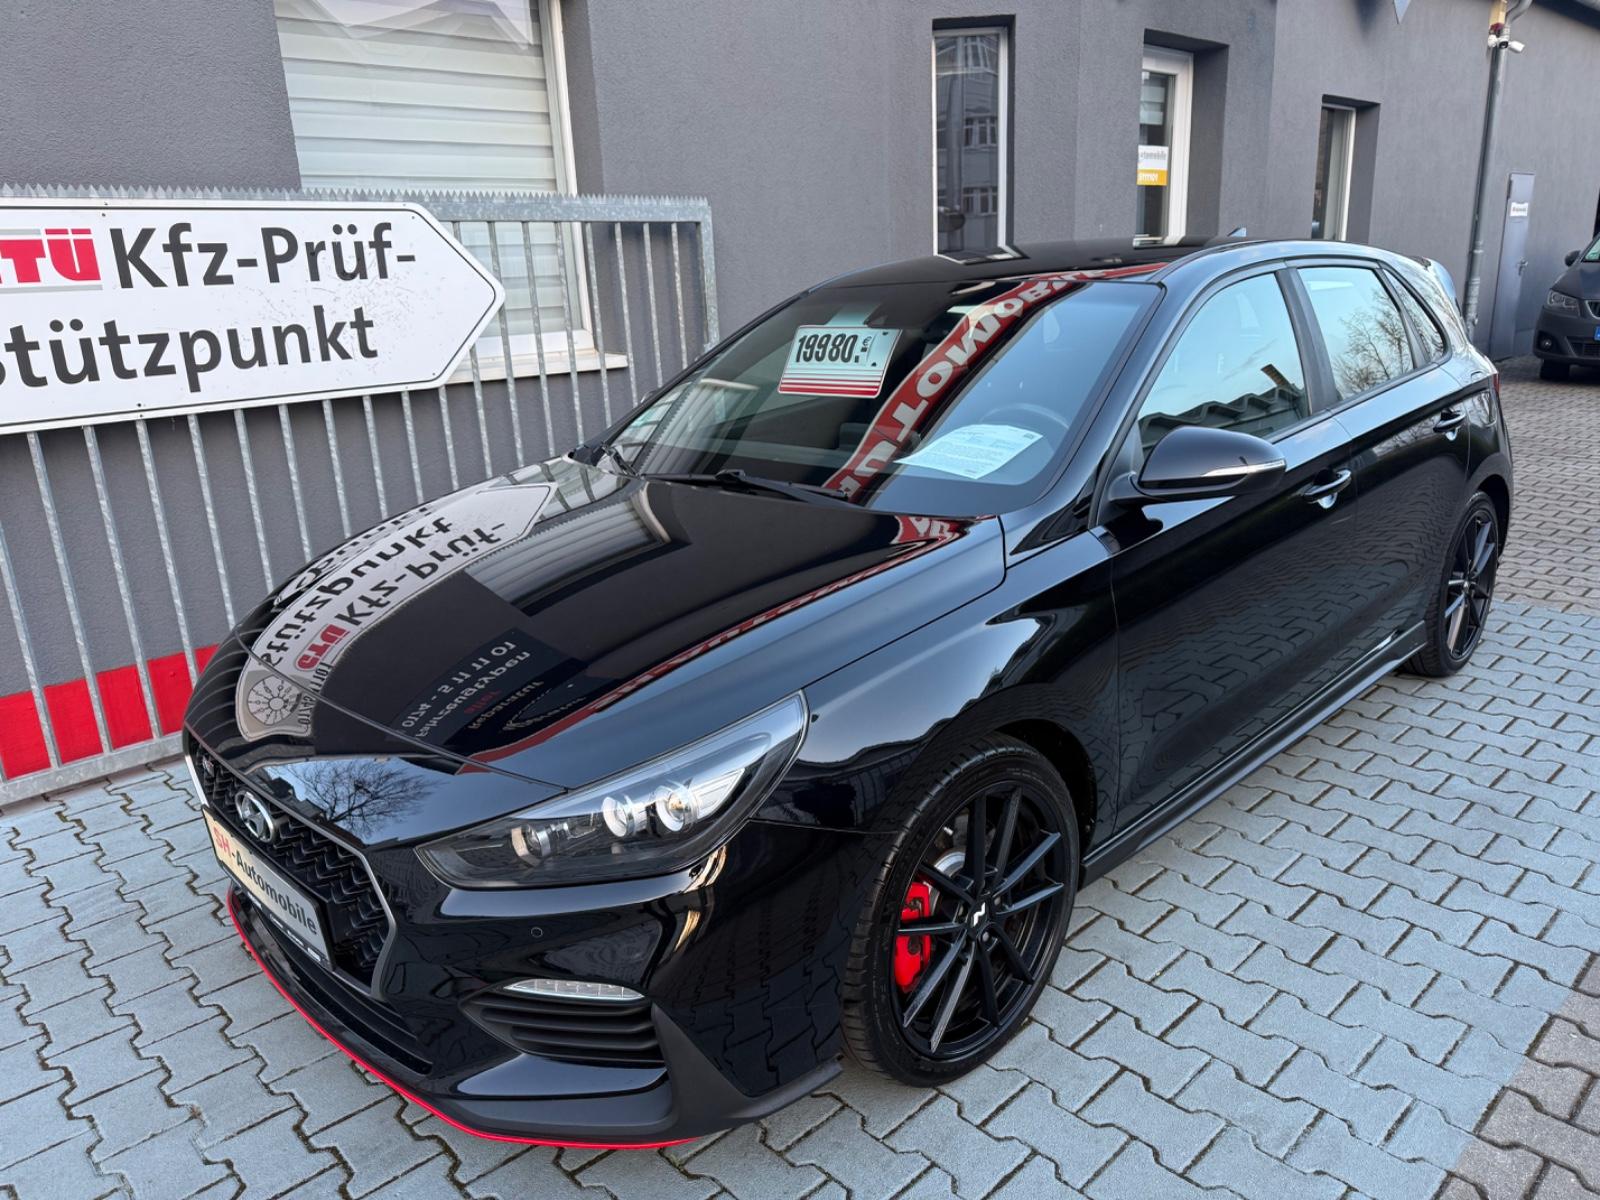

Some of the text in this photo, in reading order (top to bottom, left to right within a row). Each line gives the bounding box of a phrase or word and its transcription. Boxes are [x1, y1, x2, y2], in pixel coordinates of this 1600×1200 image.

[0, 222, 416, 289] TÜ Kfz-Prüf-
[0, 305, 378, 393] tützpunkt
